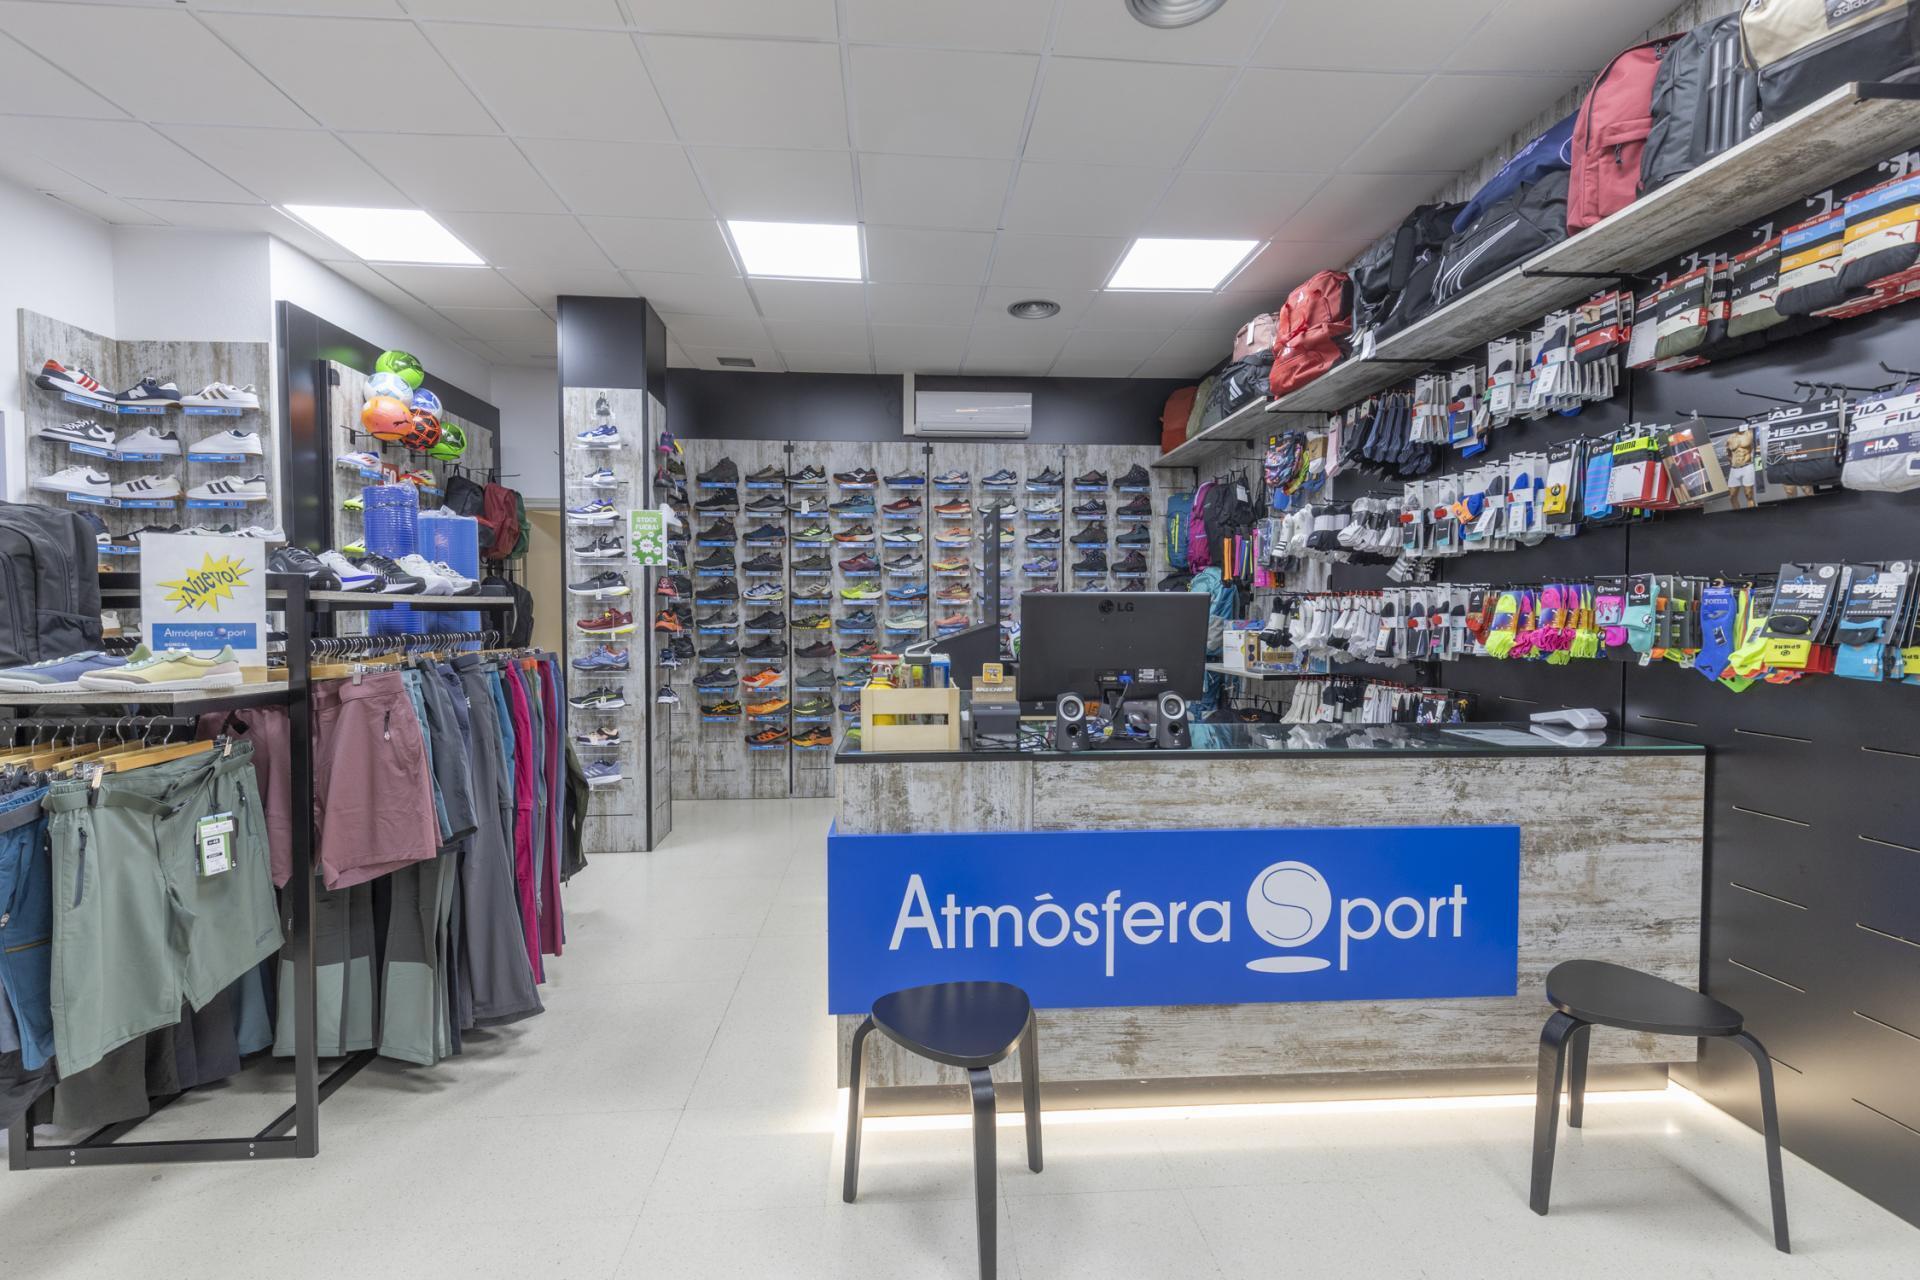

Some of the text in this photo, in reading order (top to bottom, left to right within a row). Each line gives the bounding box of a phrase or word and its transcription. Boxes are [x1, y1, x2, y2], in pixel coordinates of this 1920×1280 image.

[1884, 410, 1920, 425] FIL
[1768, 421, 1828, 438] HEAD
[1615, 440, 1637, 452] PUMA
[1864, 437, 1899, 452] FILA
[181, 567, 240, 609] ¡Nuevo!
[1781, 582, 1827, 595] SPHERE
[1117, 602, 1135, 612] LG
[888, 862, 1467, 977] Atmósfera Sport
